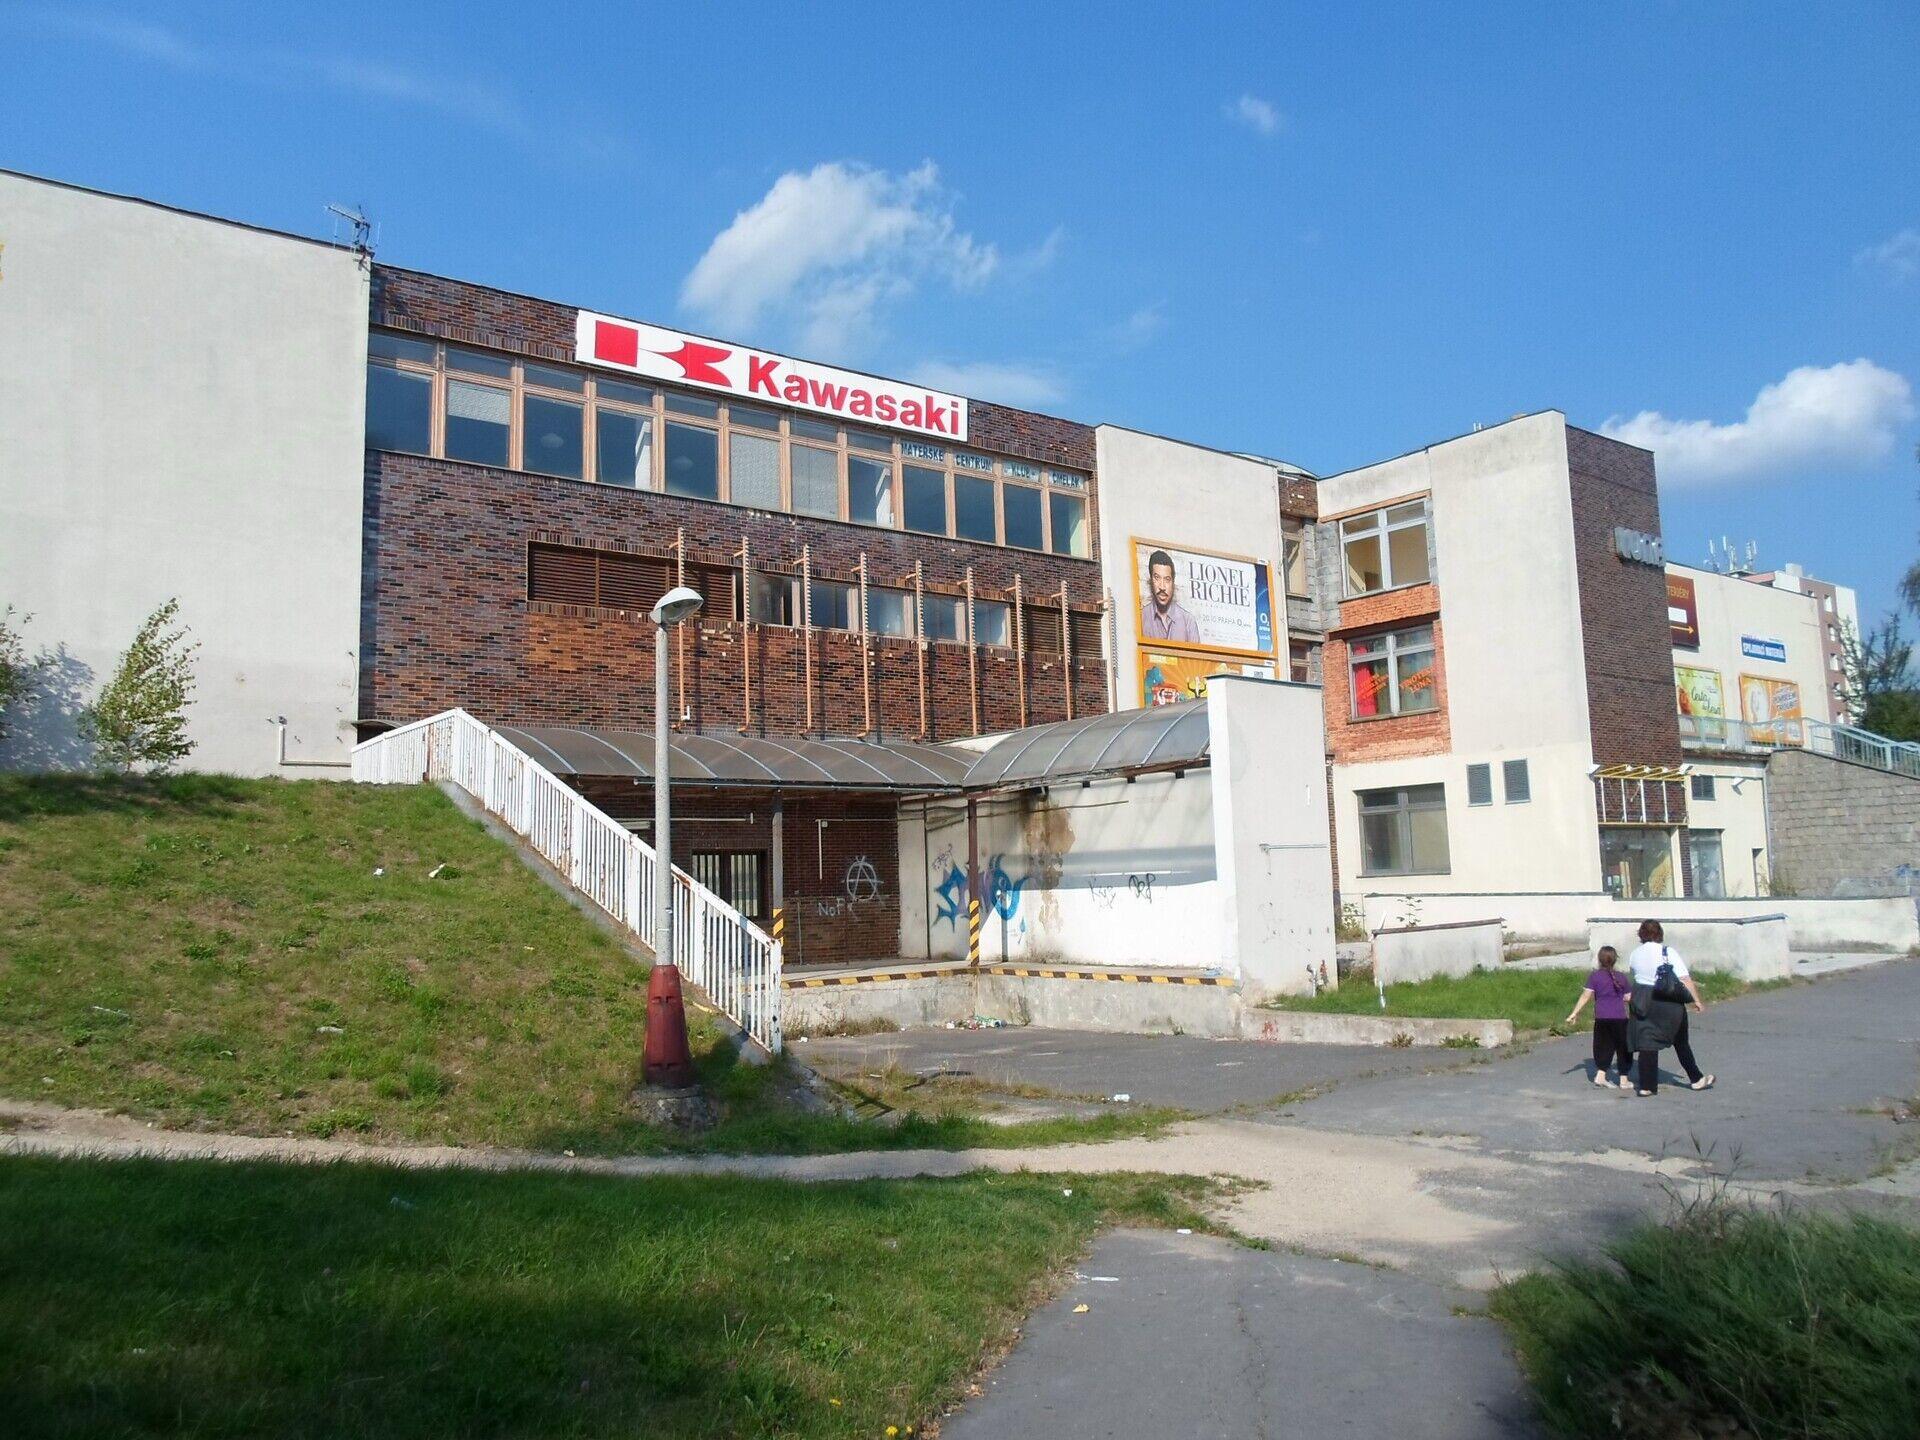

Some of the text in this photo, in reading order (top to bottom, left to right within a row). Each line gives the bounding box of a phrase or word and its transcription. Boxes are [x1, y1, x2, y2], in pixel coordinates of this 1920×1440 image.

[748, 354, 960, 435] Kawasaki
[1189, 561, 1250, 589] LIONEL
[1190, 580, 1251, 607] RICHIE
